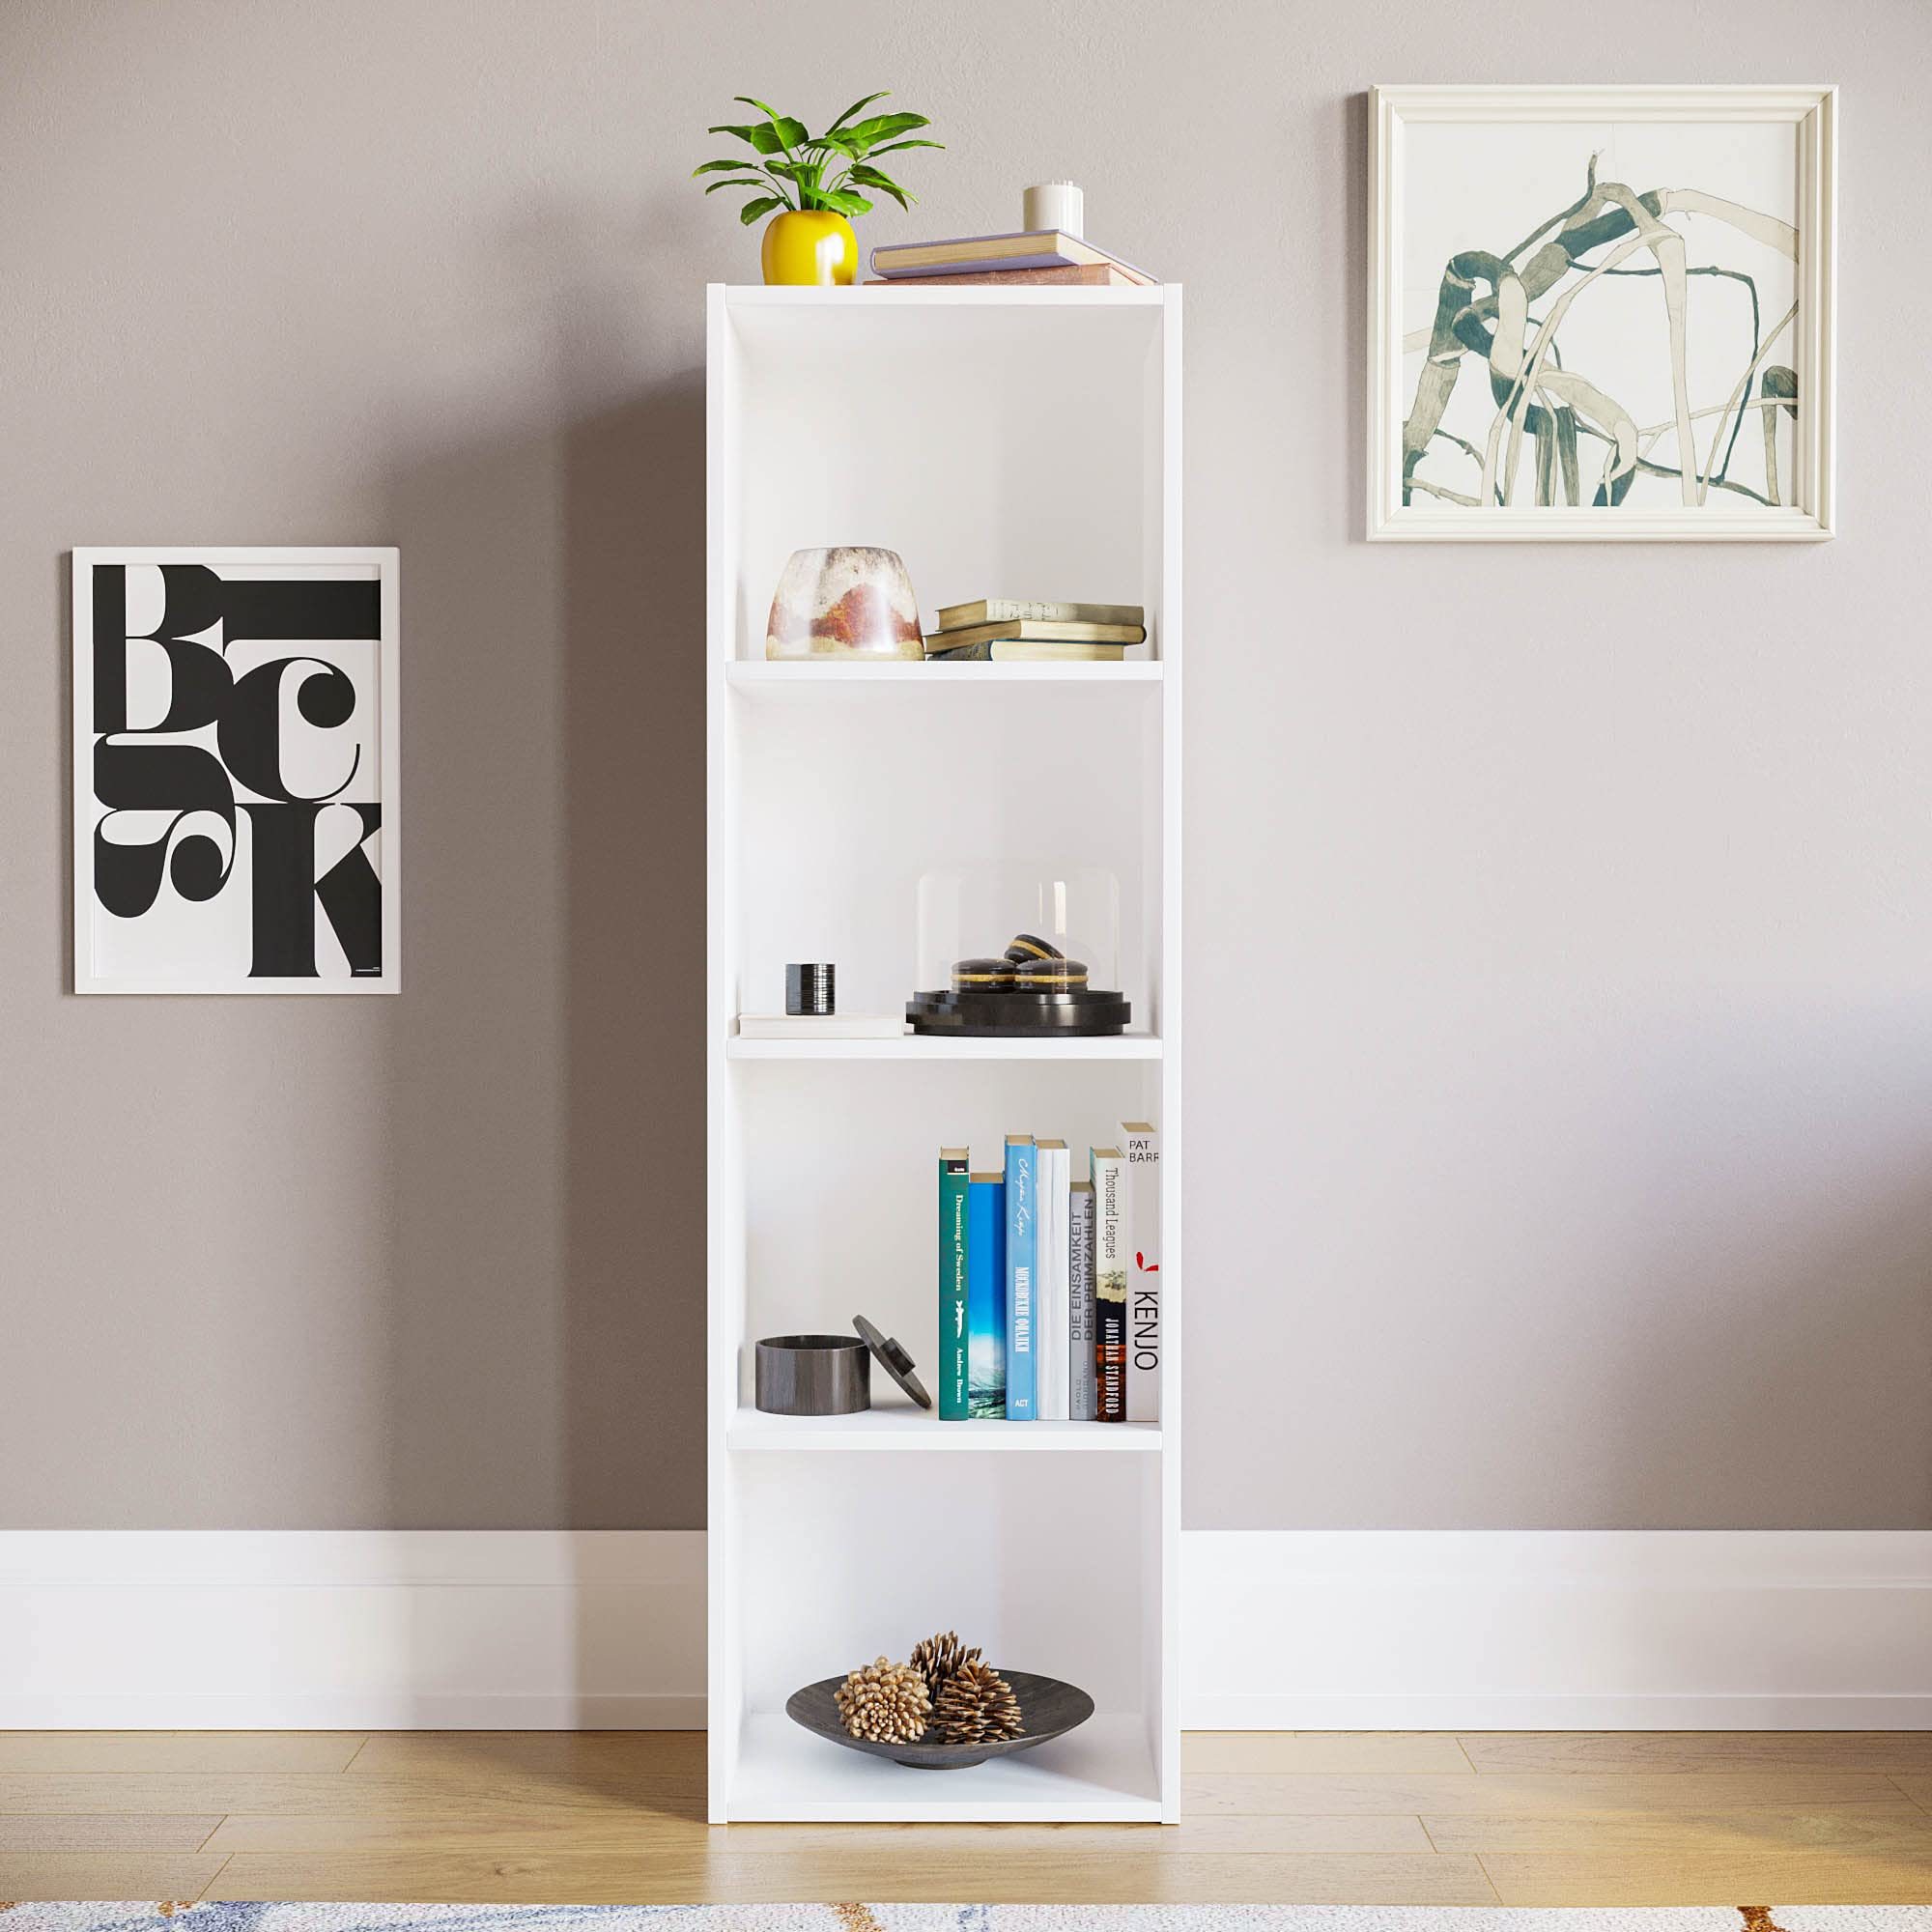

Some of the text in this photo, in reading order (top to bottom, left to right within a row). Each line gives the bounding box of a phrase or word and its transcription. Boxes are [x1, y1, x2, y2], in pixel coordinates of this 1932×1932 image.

[1129, 1140, 1151, 1150] PAT
[954, 1194, 964, 1292] Dreaming of Sweden
[1102, 1168, 1119, 1259] Thousand Leagues
[1071, 1212, 1082, 1341] DIE EINSAMKEIT
[1084, 1198, 1094, 1341] DER PRIMZAHLEN
[955, 1348, 964, 1404] Andrew Brown
[1105, 1318, 1120, 1414] JONATHAN STANDFORD
[1134, 1292, 1158, 1371] KENJO
